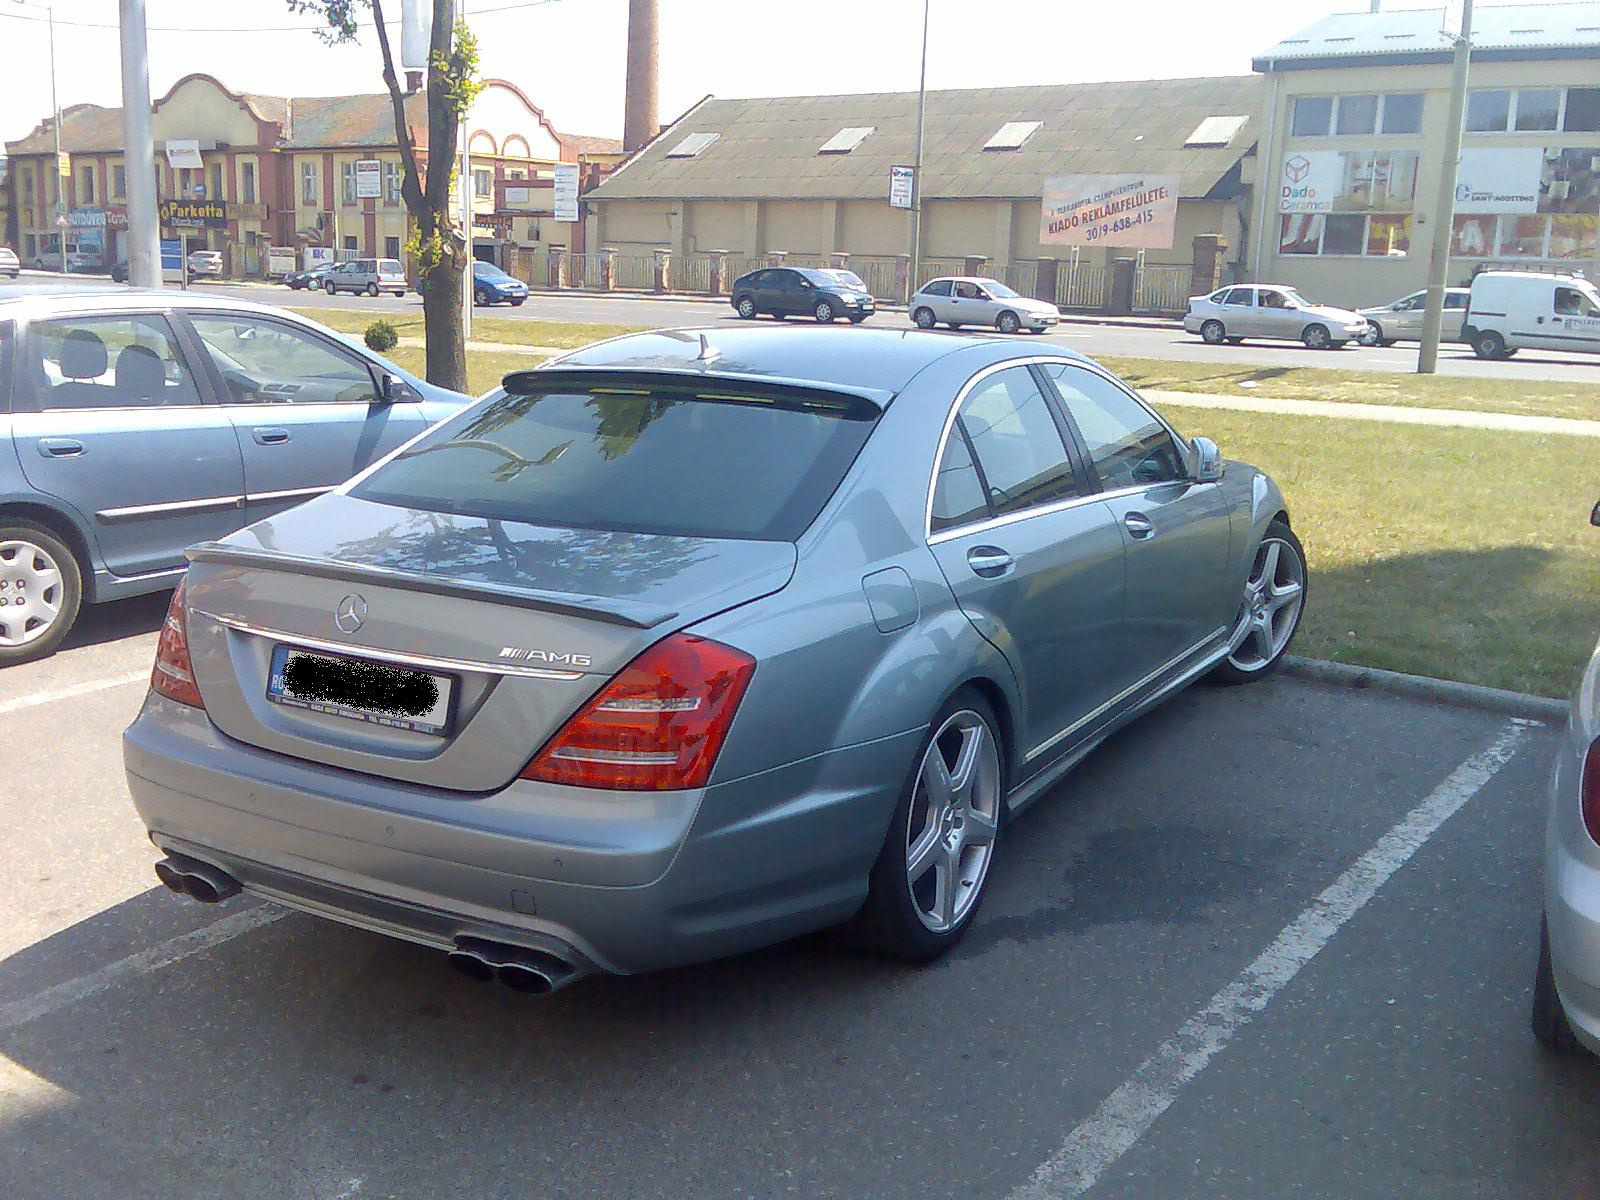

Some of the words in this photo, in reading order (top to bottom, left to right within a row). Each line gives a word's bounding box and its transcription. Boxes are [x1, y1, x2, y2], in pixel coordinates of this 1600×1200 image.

[1282, 186, 1316, 198] Dado
[169, 202, 223, 217] Parketta
[1048, 212, 1079, 234] KIADÓ
[526, 649, 592, 667] AMG
